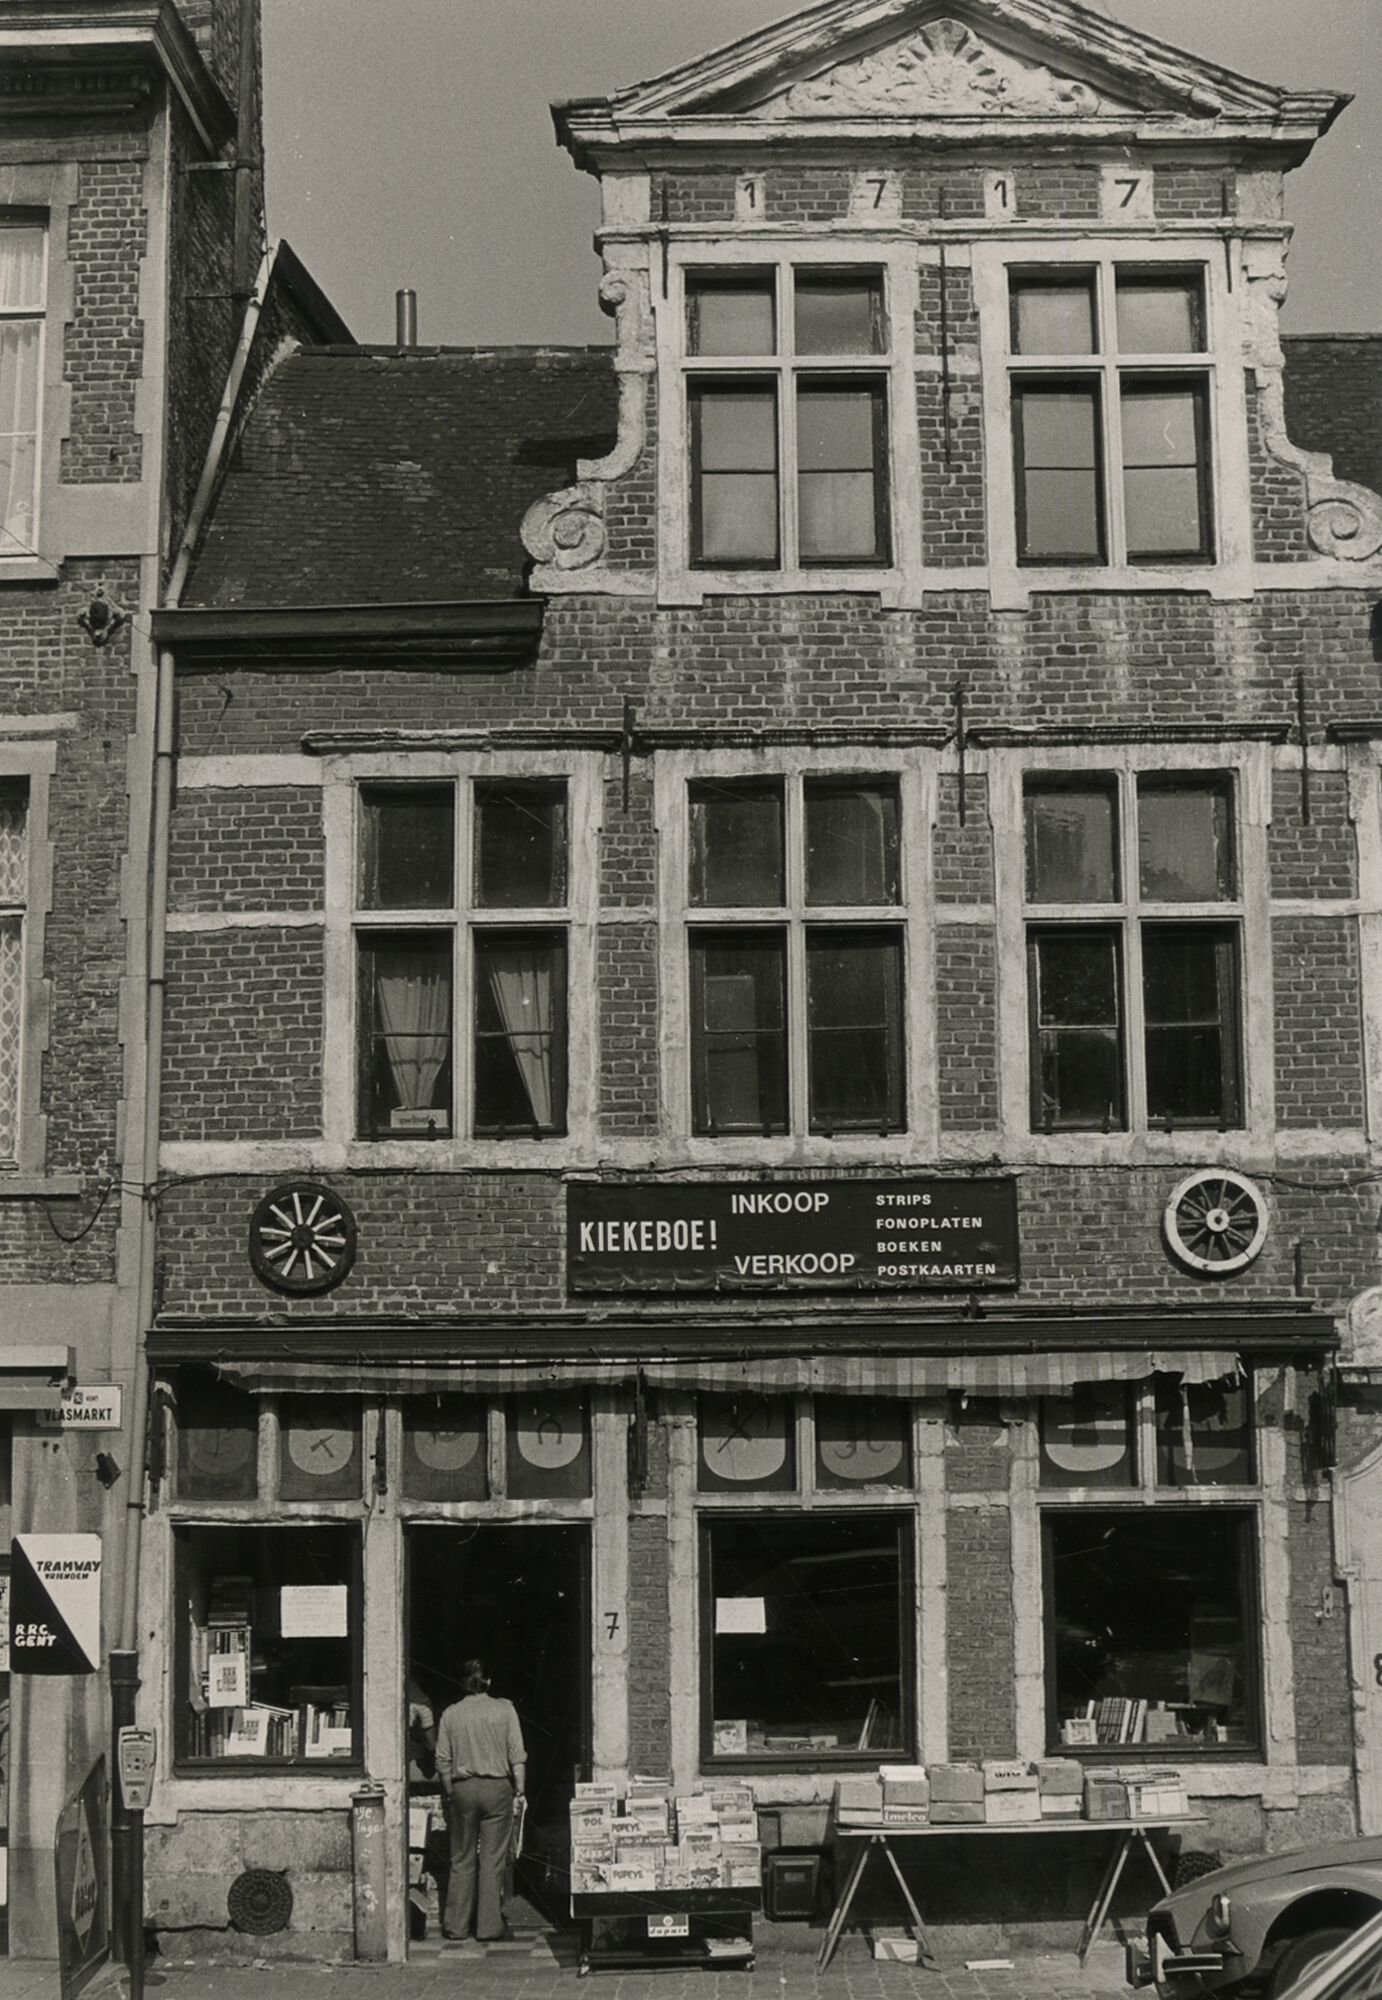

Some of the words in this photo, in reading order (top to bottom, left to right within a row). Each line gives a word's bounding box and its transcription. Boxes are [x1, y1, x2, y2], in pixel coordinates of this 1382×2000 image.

[866, 178, 887, 209] 7
[994, 179, 1007, 208] 1
[1114, 178, 1140, 208] 7
[731, 1191, 830, 1214] INKOOP
[876, 1194, 932, 1206] STRIPS
[876, 1216, 983, 1230] FONOPLATEN
[580, 1219, 717, 1252] KIEKEBOE!
[877, 1241, 942, 1253] BOEKEN
[734, 1252, 855, 1275] VERKOOP
[877, 1263, 996, 1277] POSTKAARTEN
[36, 1560, 101, 1573] TRAMWAY
[604, 1612, 619, 1640] 7
[15, 1635, 57, 1648] GENT
